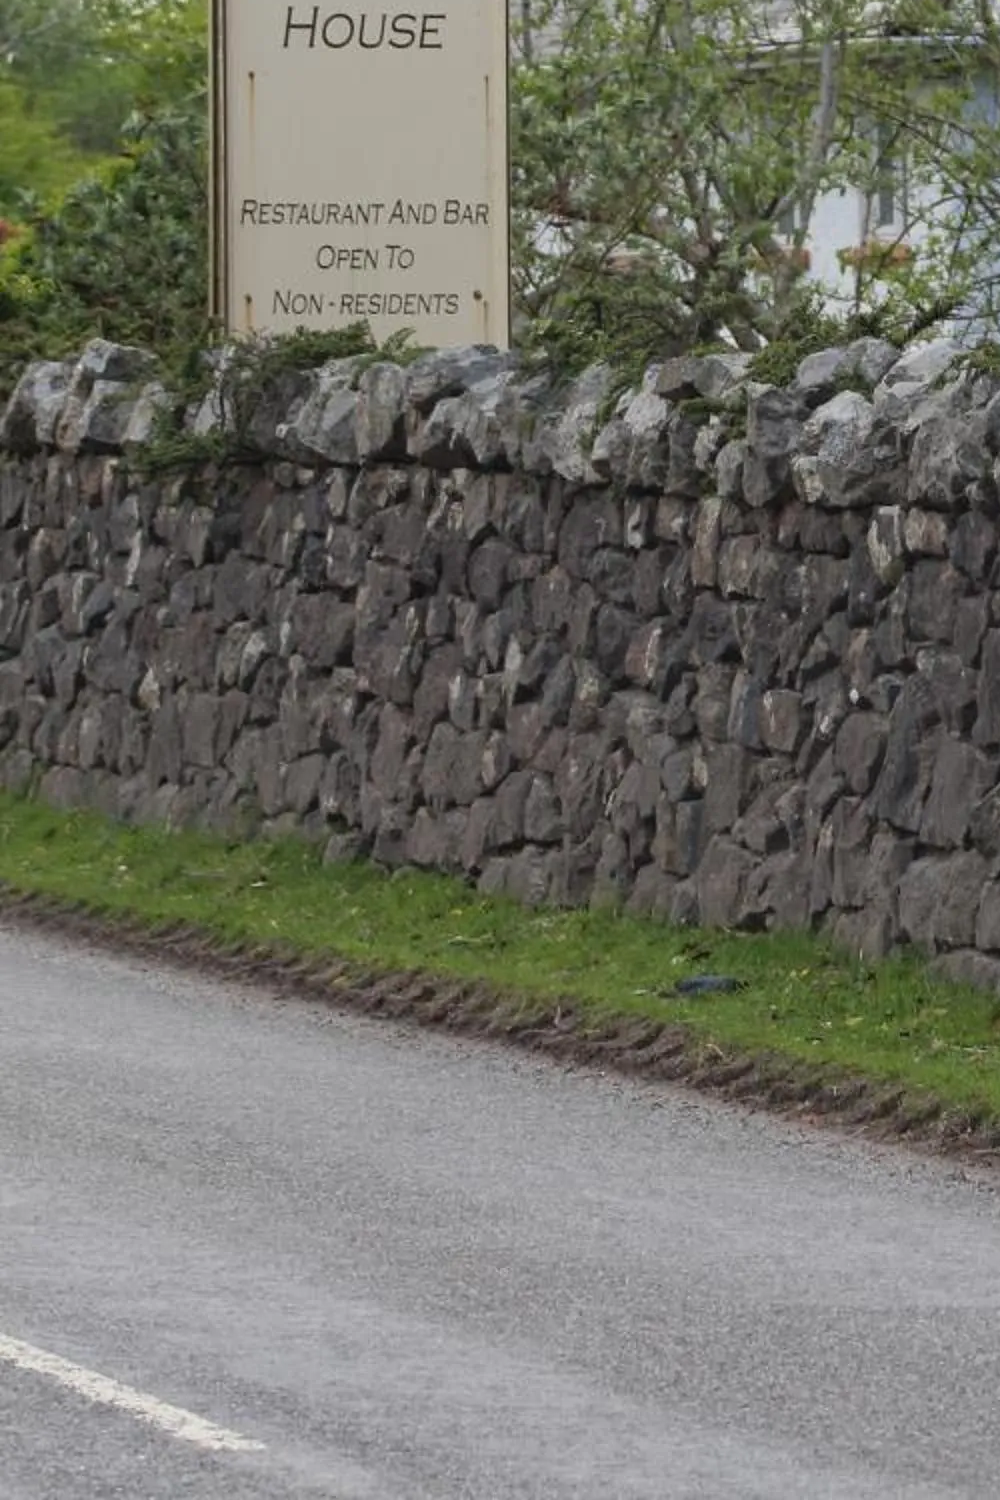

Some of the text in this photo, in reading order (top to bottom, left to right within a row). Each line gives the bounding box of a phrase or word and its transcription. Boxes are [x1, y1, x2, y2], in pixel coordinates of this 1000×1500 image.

[283, 6, 447, 49] HOUSE
[239, 200, 489, 225] RESTAURANT AND BAR
[316, 245, 415, 269] OPEN TO
